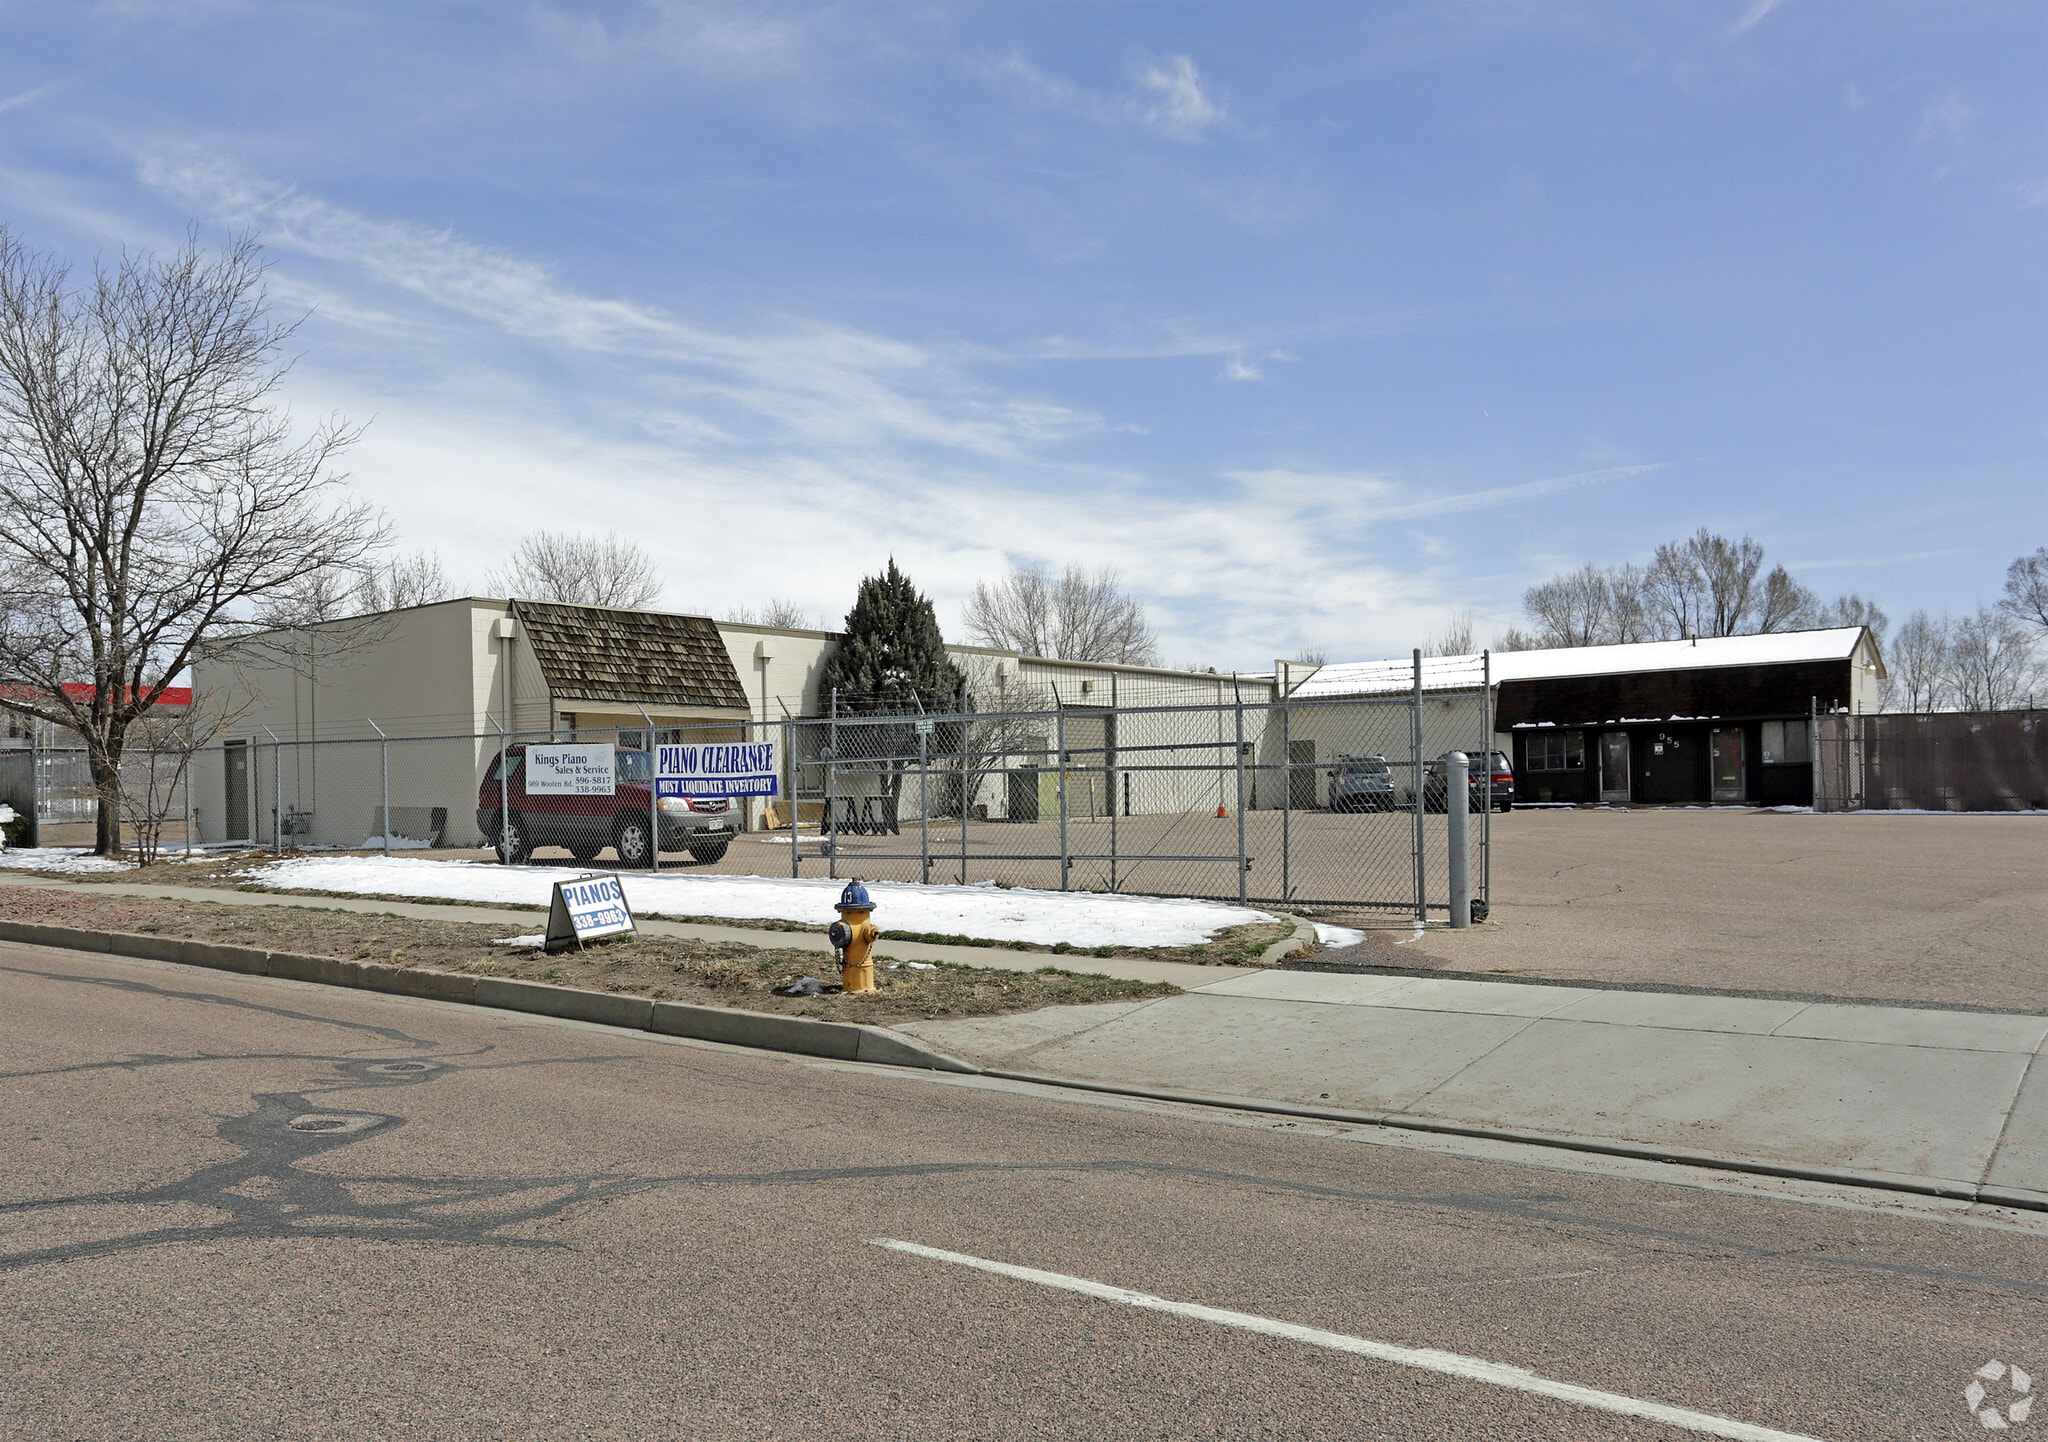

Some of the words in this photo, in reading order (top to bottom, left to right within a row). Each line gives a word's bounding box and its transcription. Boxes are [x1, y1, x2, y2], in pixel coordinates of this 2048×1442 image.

[1659, 733, 1680, 748] 955
[535, 754, 559, 767] Kings
[562, 753, 587, 764] Piano
[659, 746, 698, 774] PIANO
[702, 743, 773, 774] CLEARANCE
[555, 766, 573, 774] Sales
[575, 766, 581, 774] &
[583, 765, 609, 774] Service
[575, 776, 611, 784] 596-5817
[659, 780, 680, 793] MUST
[681, 780, 724, 794] LIQUIDATE
[725, 778, 773, 793] INVENTORY
[575, 785, 611, 793] 338-9963
[563, 880, 622, 907] PIANOS
[844, 891, 853, 903] 13
[573, 909, 624, 929] 338-9963
